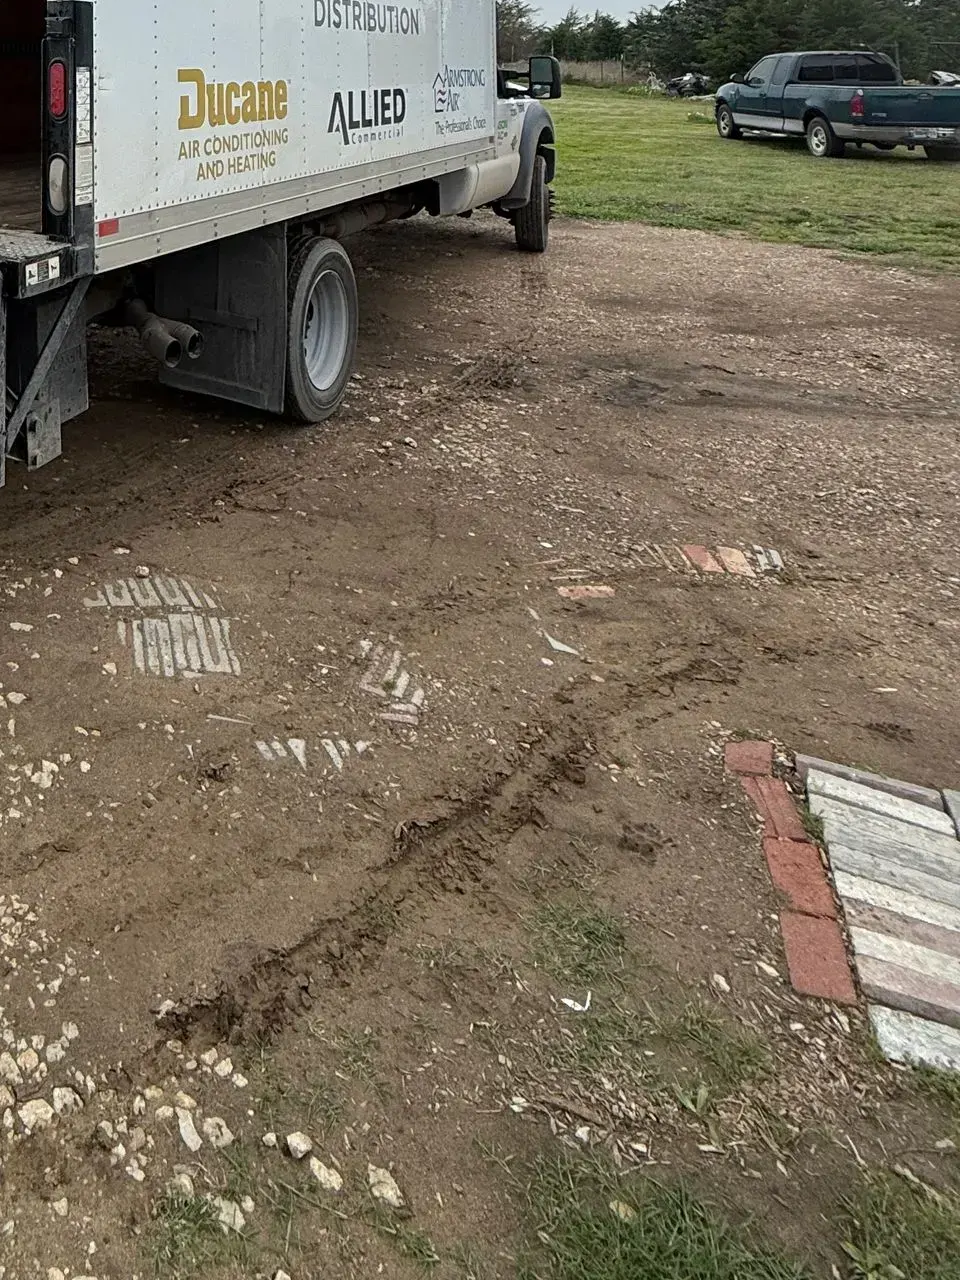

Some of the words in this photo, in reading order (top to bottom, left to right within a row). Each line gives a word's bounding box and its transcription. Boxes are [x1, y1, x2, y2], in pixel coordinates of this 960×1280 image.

[442, 64, 486, 88] ARMSTRONG
[177, 68, 288, 131] Ducane
[327, 88, 406, 146] ALLIED
[178, 139, 201, 161] AIR
[203, 127, 289, 157] CONDITIONING
[351, 125, 404, 145] Commercial
[196, 159, 225, 182] AND
[227, 150, 277, 176] HEATING
